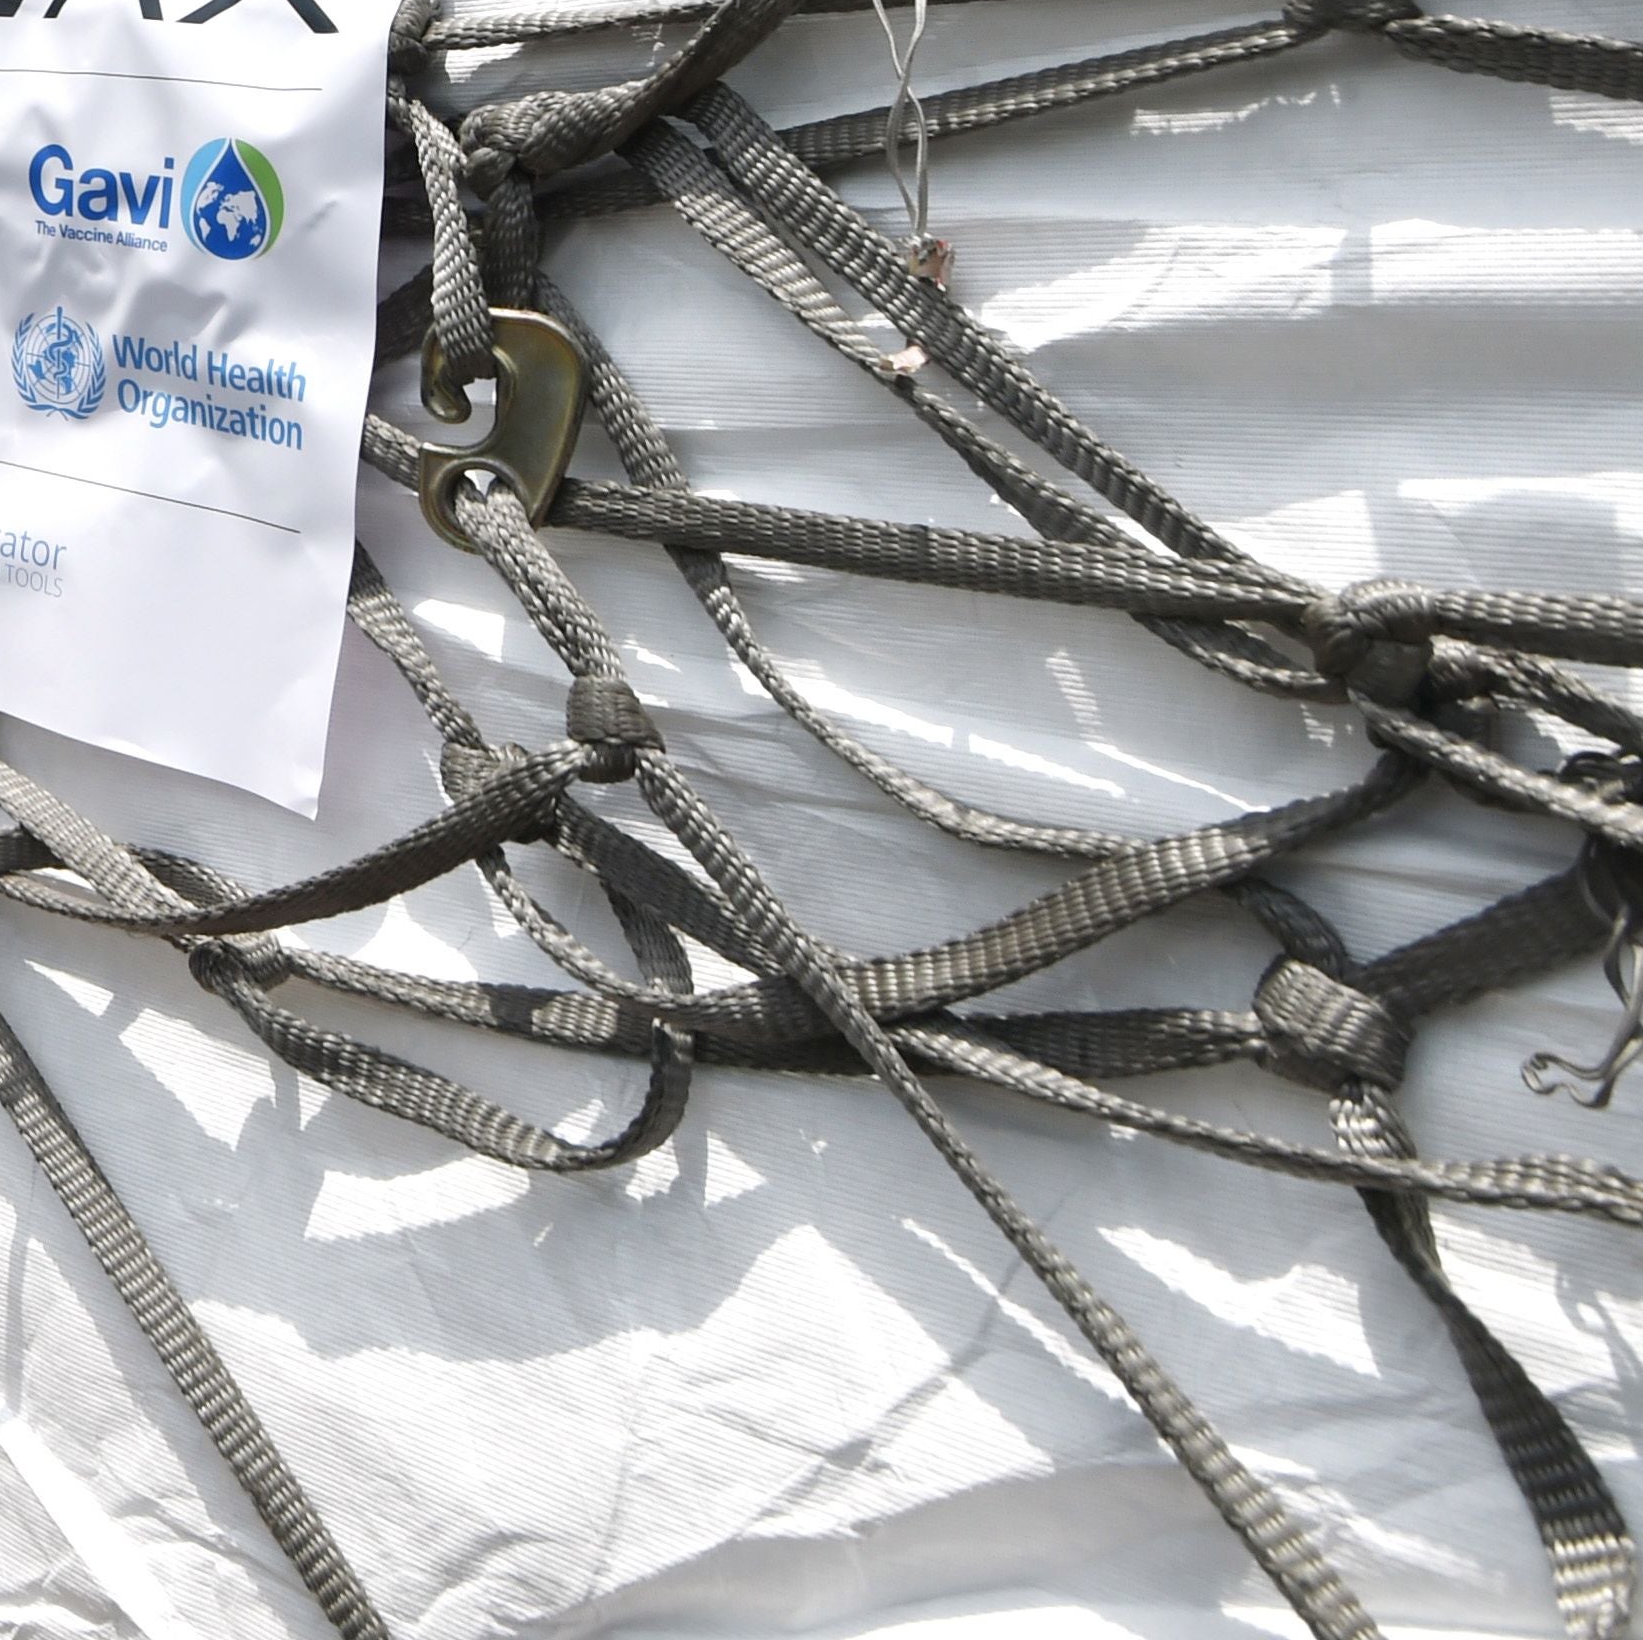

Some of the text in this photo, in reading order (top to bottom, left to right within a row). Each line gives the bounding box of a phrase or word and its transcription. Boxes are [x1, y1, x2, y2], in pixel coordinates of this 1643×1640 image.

[28, 143, 175, 230] Gavi
[35, 219, 168, 253] The Vaccine Alliance
[112, 334, 307, 402] World Health
[117, 378, 303, 451] Organization
[5, 563, 64, 598] TOOLS
